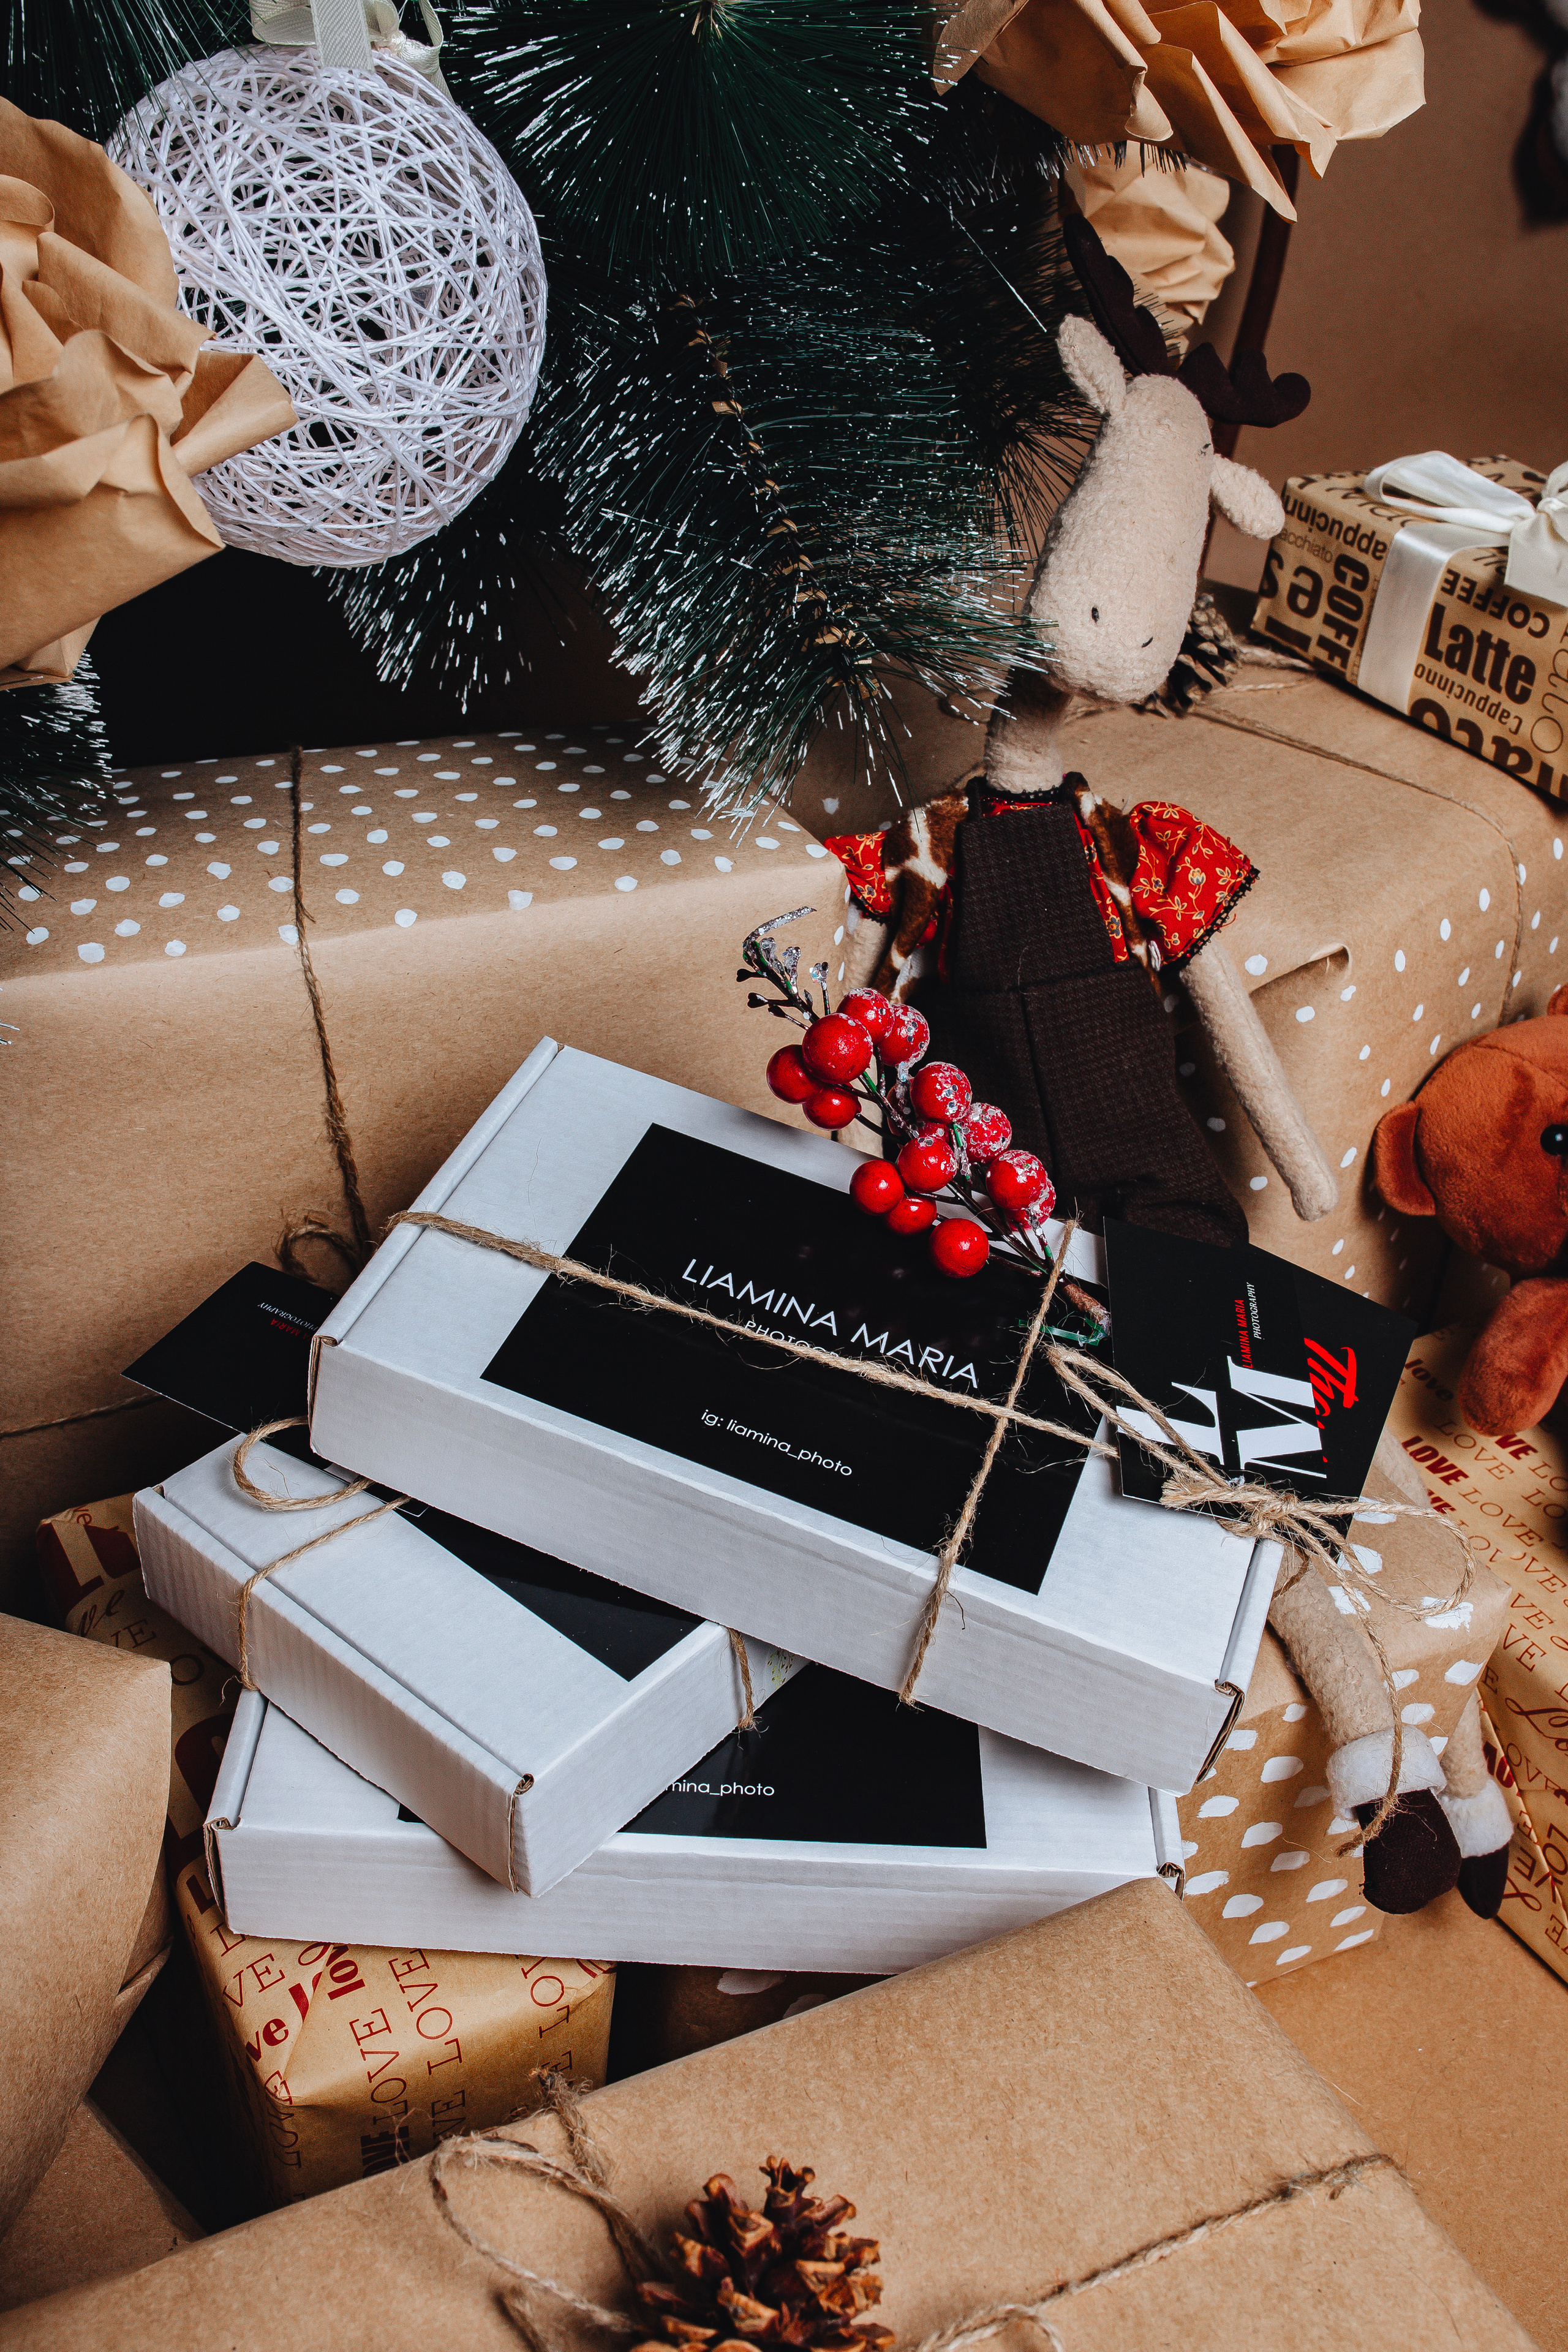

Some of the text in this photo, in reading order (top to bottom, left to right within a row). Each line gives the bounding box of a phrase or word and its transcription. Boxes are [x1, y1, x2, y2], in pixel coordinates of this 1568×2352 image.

[1280, 527, 1333, 564] acchiato
[1283, 488, 1388, 562] appucinn
[1440, 567, 1551, 639] COFFEE
[1423, 602, 1536, 705] Latte
[682, 1259, 978, 1389] LIAMINA MARIA
[1234, 1299, 1253, 1368] LIAMINA MARIA
[1246, 1282, 1262, 1340] PHOTOGRAPHY
[701, 1409, 853, 1476] ig: liamina_photo
[1401, 1435, 1469, 1486] LOVE
[1434, 1420, 1515, 1480] LOVE
[1458, 1487, 1545, 1547] LOVE
[665, 1779, 775, 1797] mina_photo
[388, 1948, 462, 2075] LOVE
[349, 2008, 407, 2125] LOVE
